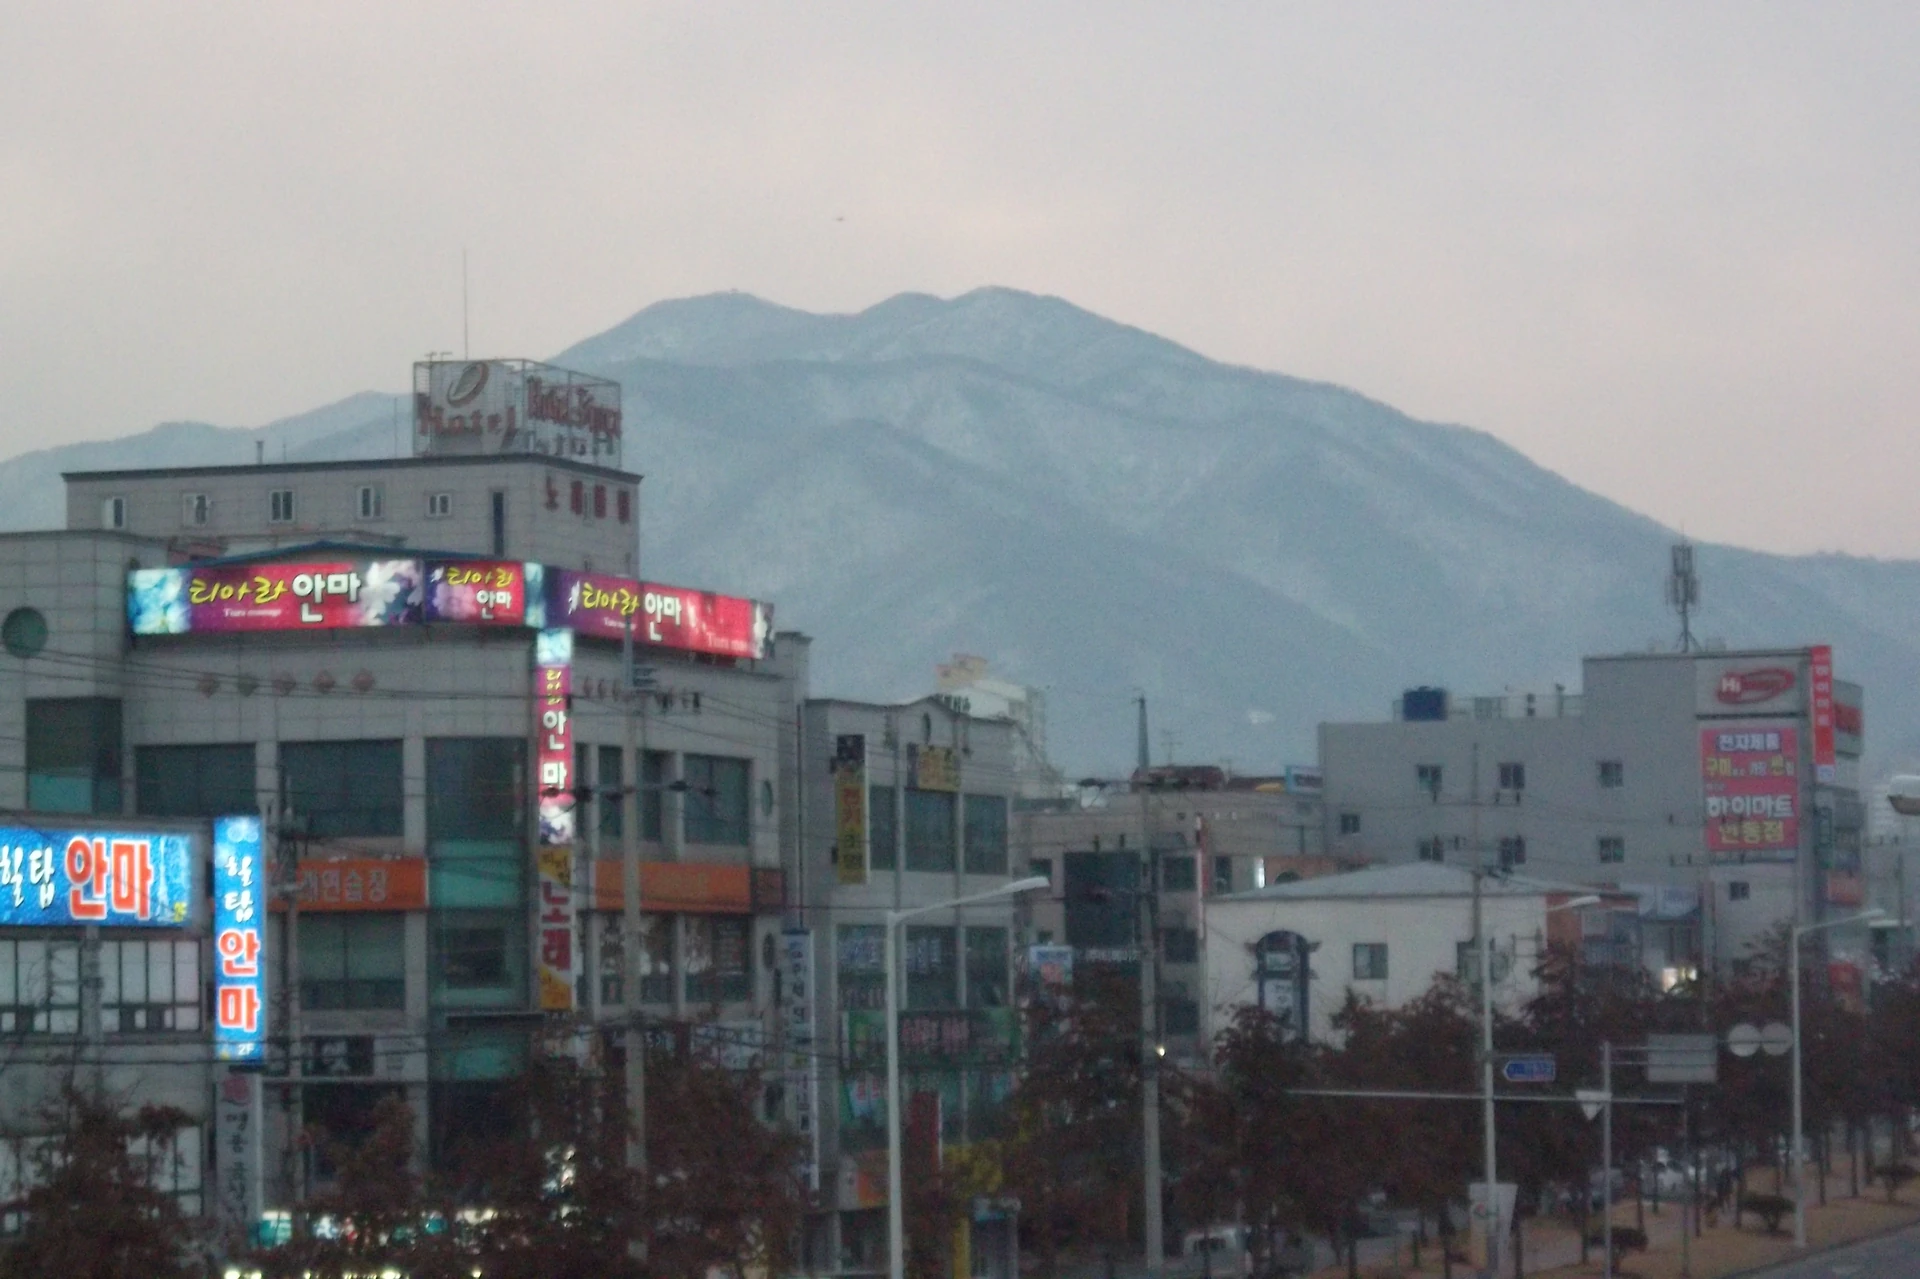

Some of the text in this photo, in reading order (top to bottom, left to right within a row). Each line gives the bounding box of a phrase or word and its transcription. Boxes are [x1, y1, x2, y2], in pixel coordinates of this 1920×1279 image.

[292, 573, 362, 623] 안마
[476, 590, 512, 620] 안마
[644, 592, 682, 641] 안마
[542, 710, 567, 790] 안마
[1706, 795, 1794, 818] 하이마트
[0, 836, 154, 920] 힐탑 안마
[218, 856, 260, 1032] 힐탑 안마
[541, 881, 571, 971] 노래
[237, 1043, 255, 1057] 2F
